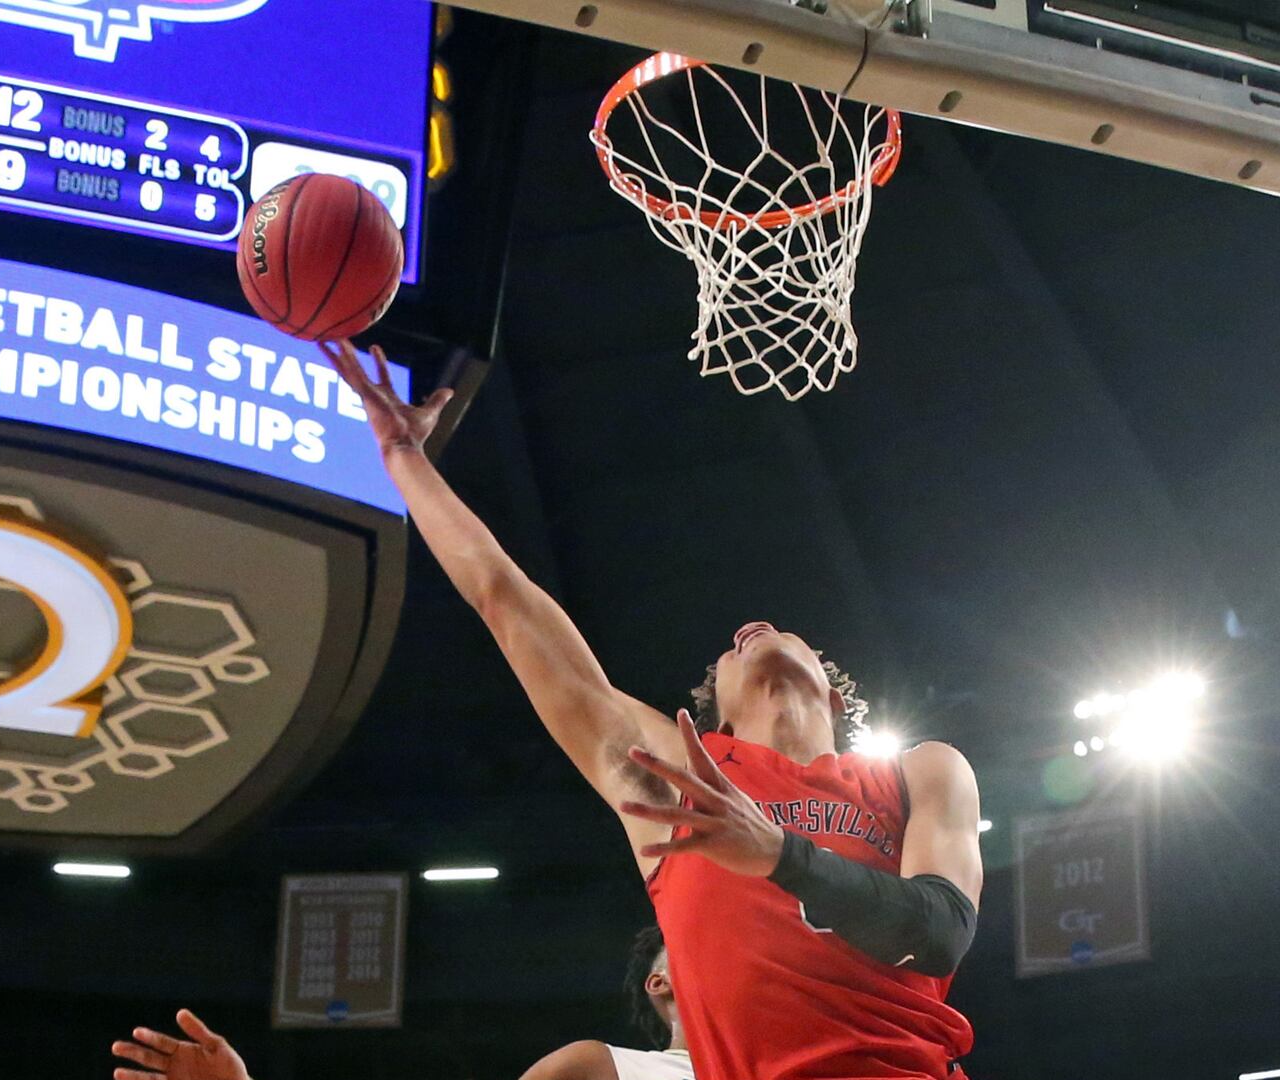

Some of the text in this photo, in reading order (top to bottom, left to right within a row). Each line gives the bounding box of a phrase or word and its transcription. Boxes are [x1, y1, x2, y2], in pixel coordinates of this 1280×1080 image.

[63, 106, 125, 136] BONUS
[144, 119, 169, 151] 2
[199, 135, 221, 162] 4
[49, 138, 232, 190] BONUS FLS TOL
[57, 169, 118, 201] BONUS
[139, 180, 163, 211] 0
[195, 194, 216, 221] 5
[206, 336, 368, 422] STATE
[755, 798, 894, 856] NESVILLE
